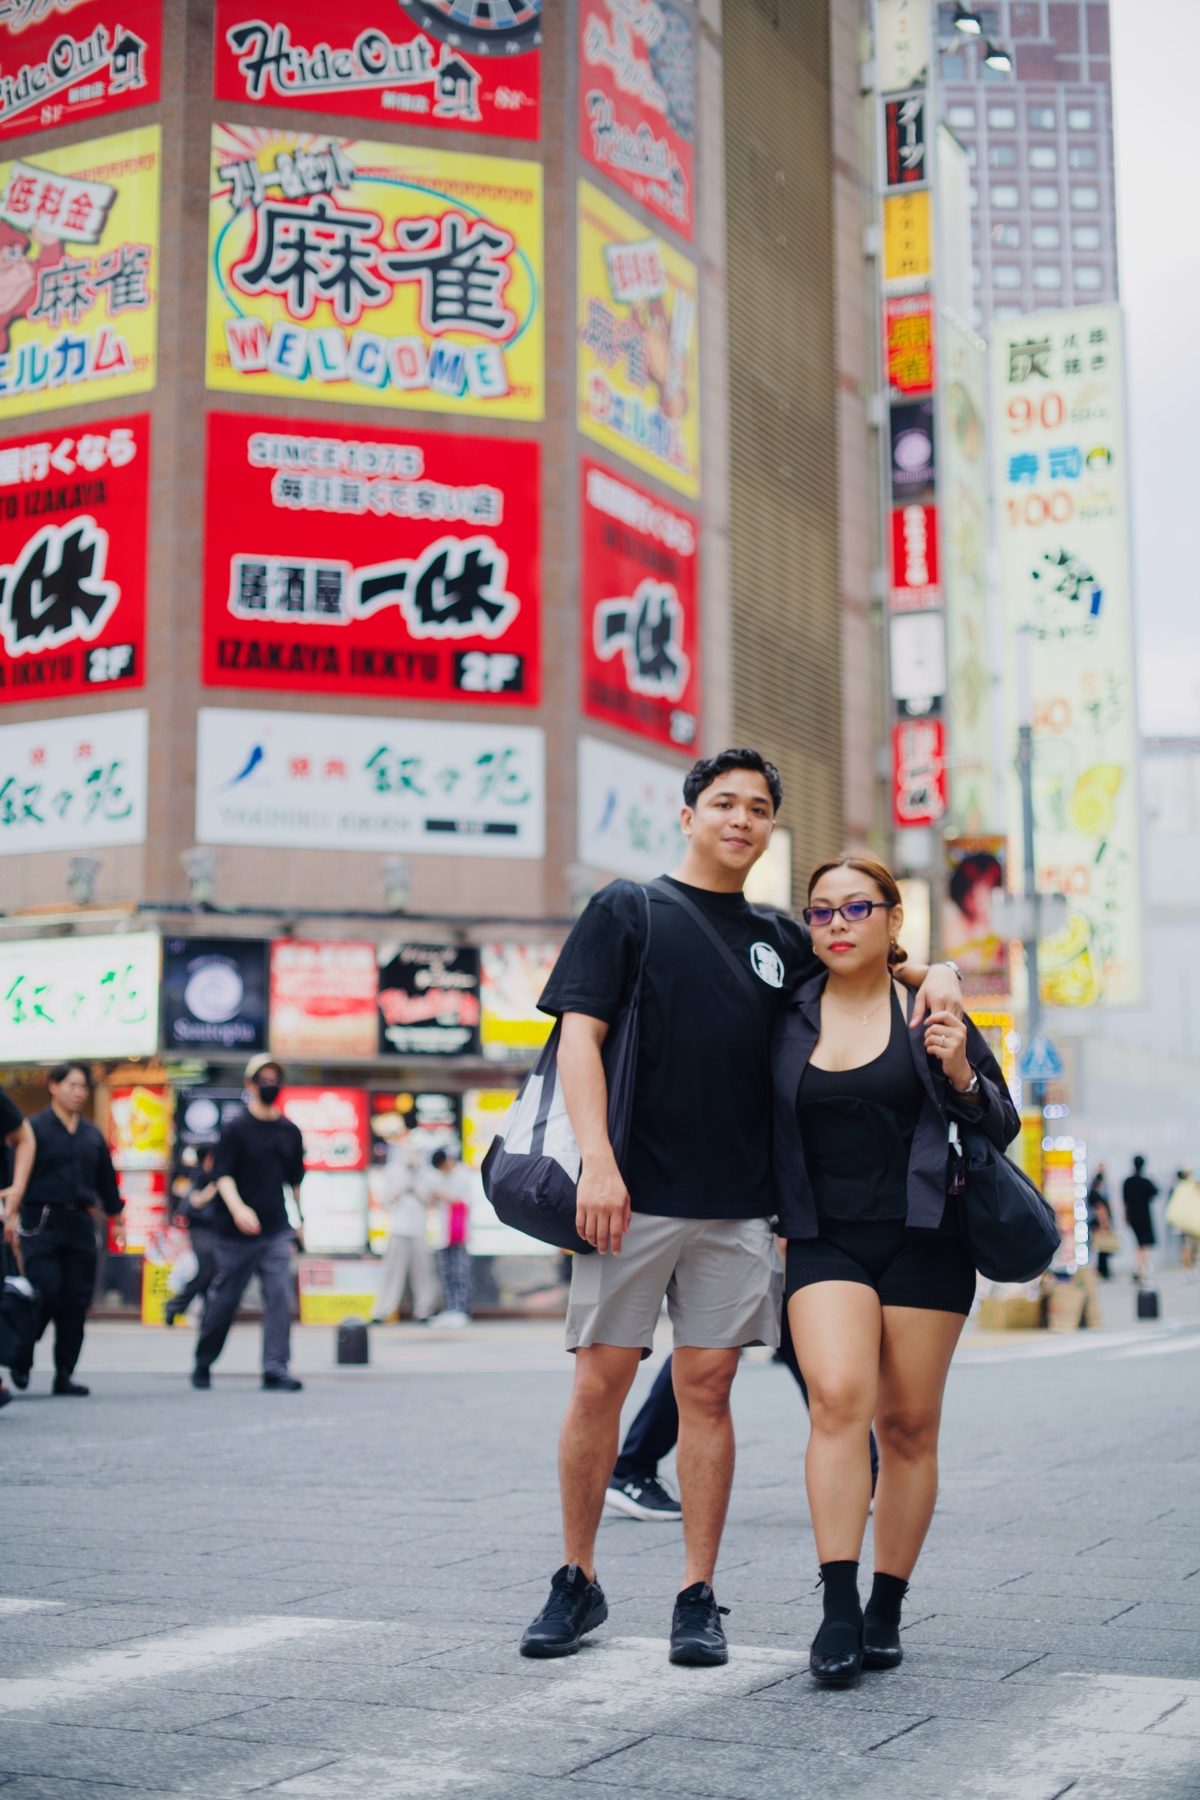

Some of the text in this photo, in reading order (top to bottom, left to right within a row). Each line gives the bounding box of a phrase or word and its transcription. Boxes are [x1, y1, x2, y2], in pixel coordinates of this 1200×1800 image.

[6, 173, 96, 232] 低料金
[28, 243, 154, 327] 麻雀
[238, 200, 514, 338] 麻雀
[226, 317, 507, 397] WELCOME
[1007, 392, 1065, 434] 90
[25, 480, 105, 516] IZAKAYA
[0, 515, 120, 656] 休
[12, 644, 132, 687] IKKYU 2F
[217, 639, 438, 681] IZAKAYA IKKYU
[460, 650, 519, 693] 2F
